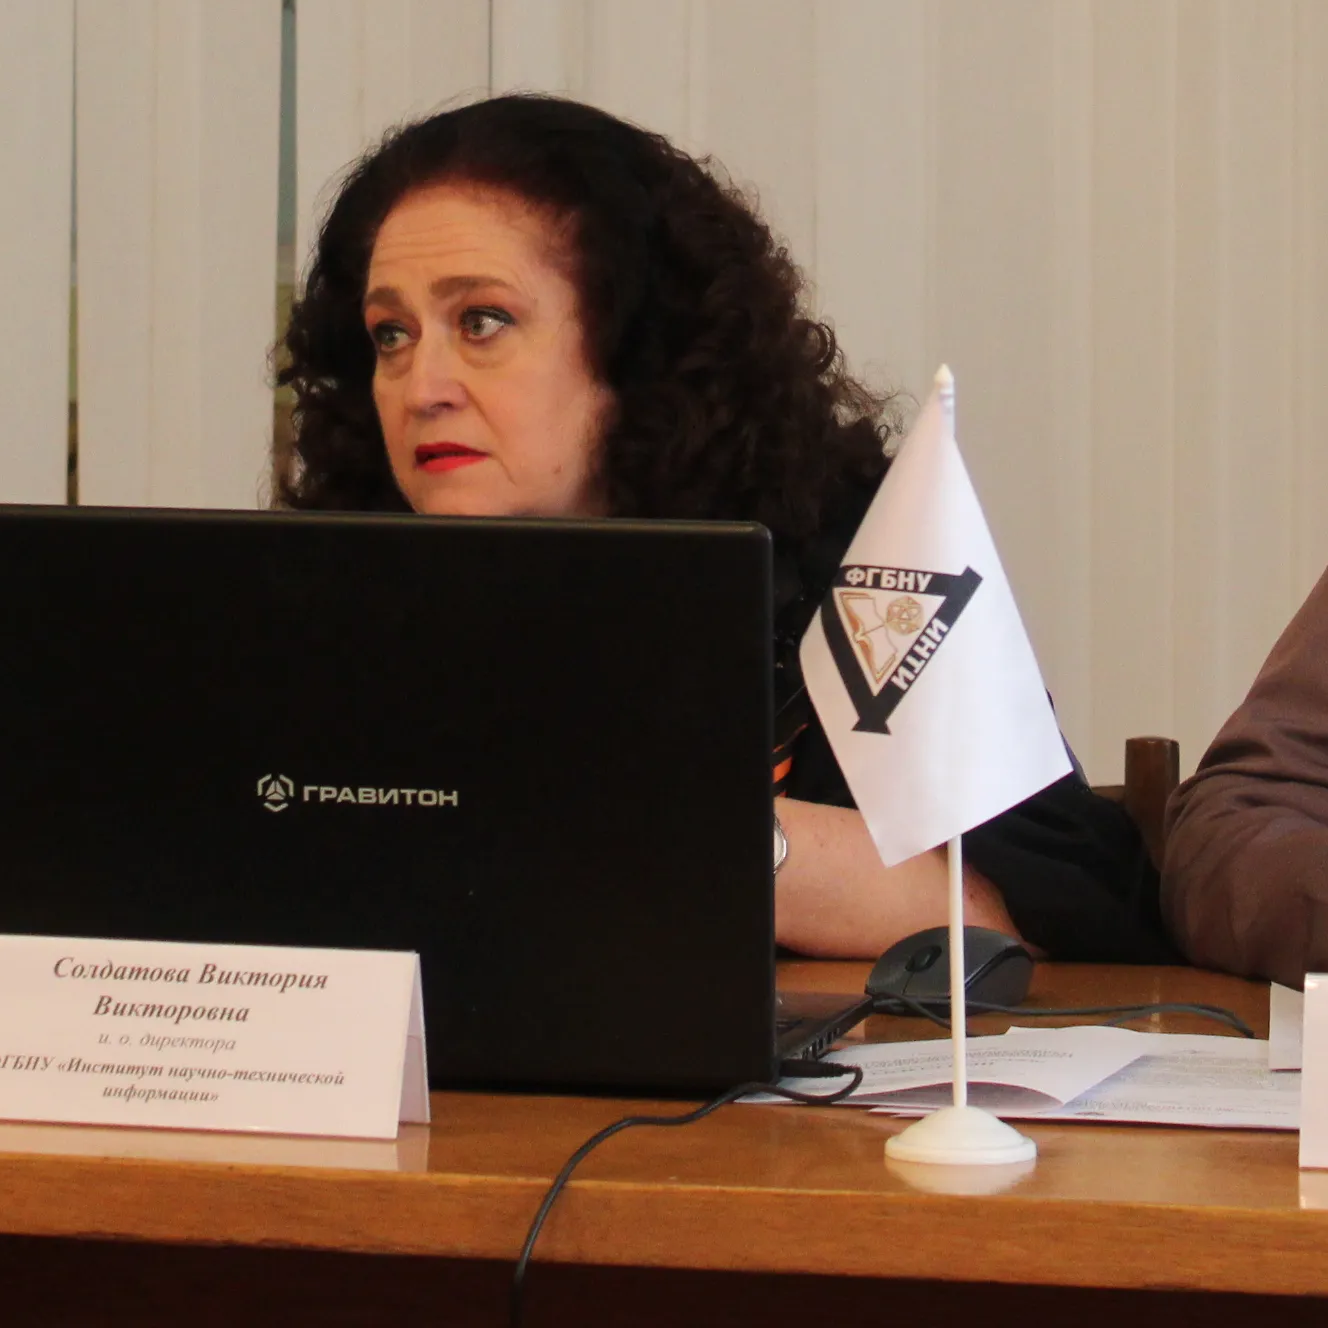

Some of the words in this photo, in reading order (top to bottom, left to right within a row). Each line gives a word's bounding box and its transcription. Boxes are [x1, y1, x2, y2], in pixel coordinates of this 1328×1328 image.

[845, 568, 932, 592] ФГБНУ
[891, 617, 949, 691] ИНТИ
[303, 785, 458, 807] ГРАВИТОН
[53, 956, 190, 984] Солдатова
[198, 963, 329, 993] Виктория
[92, 995, 250, 1025] Викторовна
[139, 1032, 237, 1054] директора
[58, 1057, 164, 1079] «Институт
[167, 1065, 345, 1086] научно-технической
[102, 1083, 219, 1104] информации»
